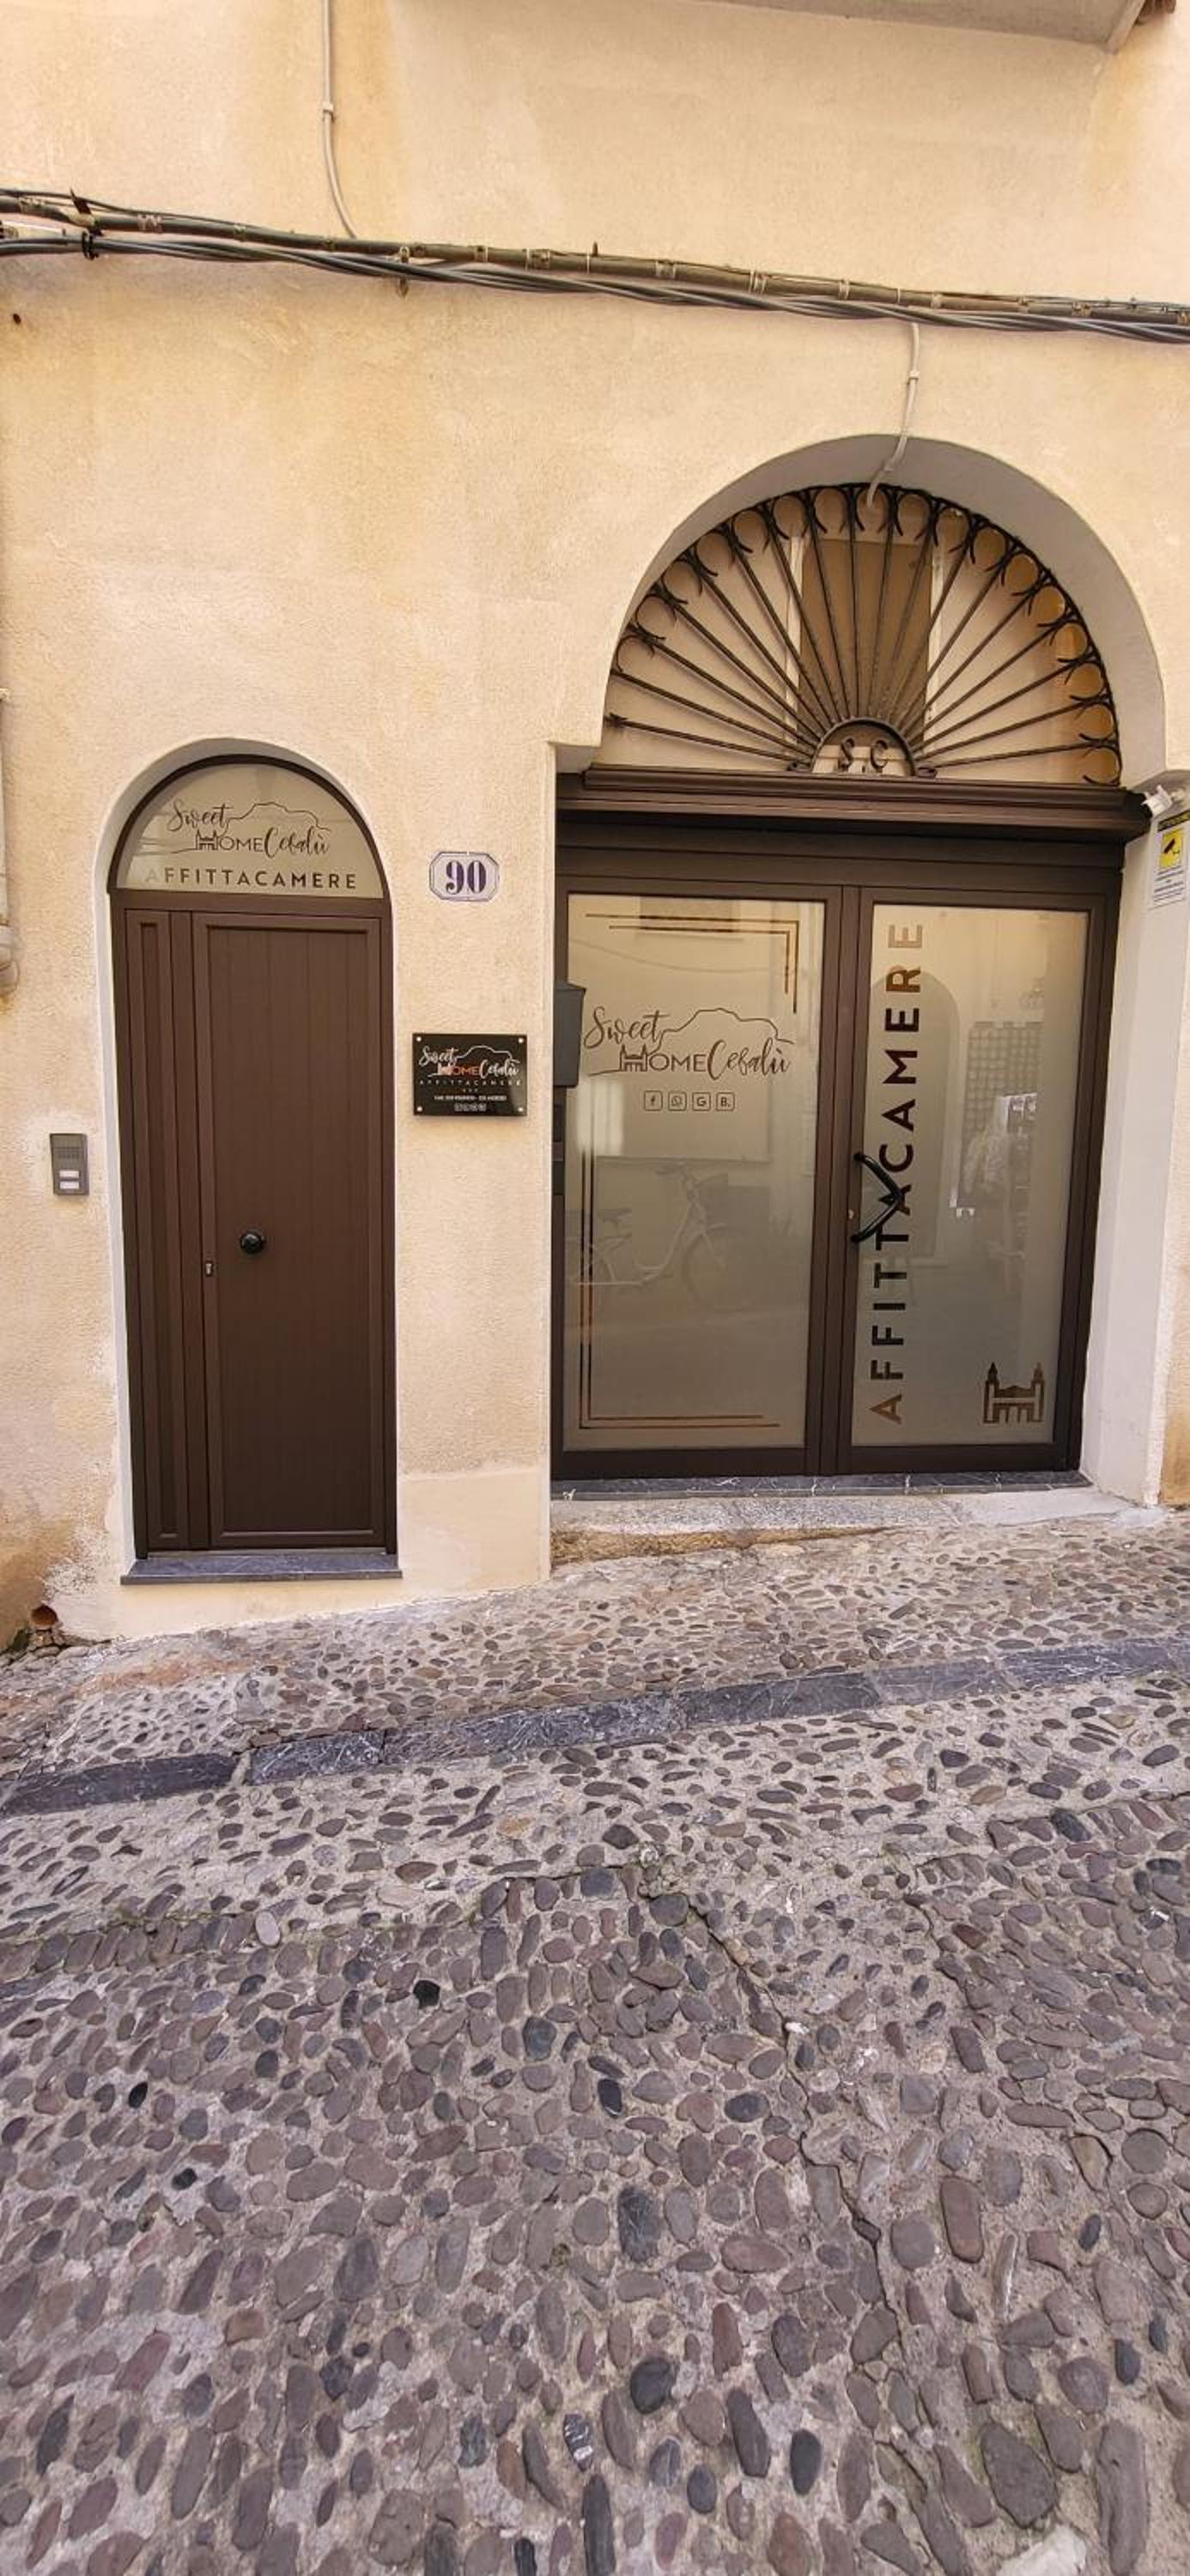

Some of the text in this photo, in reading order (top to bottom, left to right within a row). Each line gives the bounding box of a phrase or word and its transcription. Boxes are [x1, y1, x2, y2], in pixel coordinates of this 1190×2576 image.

[167, 799, 234, 833] Sweet
[145, 867, 357, 890] AFFITTACAMERE
[446, 860, 487, 895] 90
[584, 1005, 670, 1049] Sweet
[418, 1045, 458, 1066] Sweet
[869, 923, 924, 1425] AFFITTACAMERE
